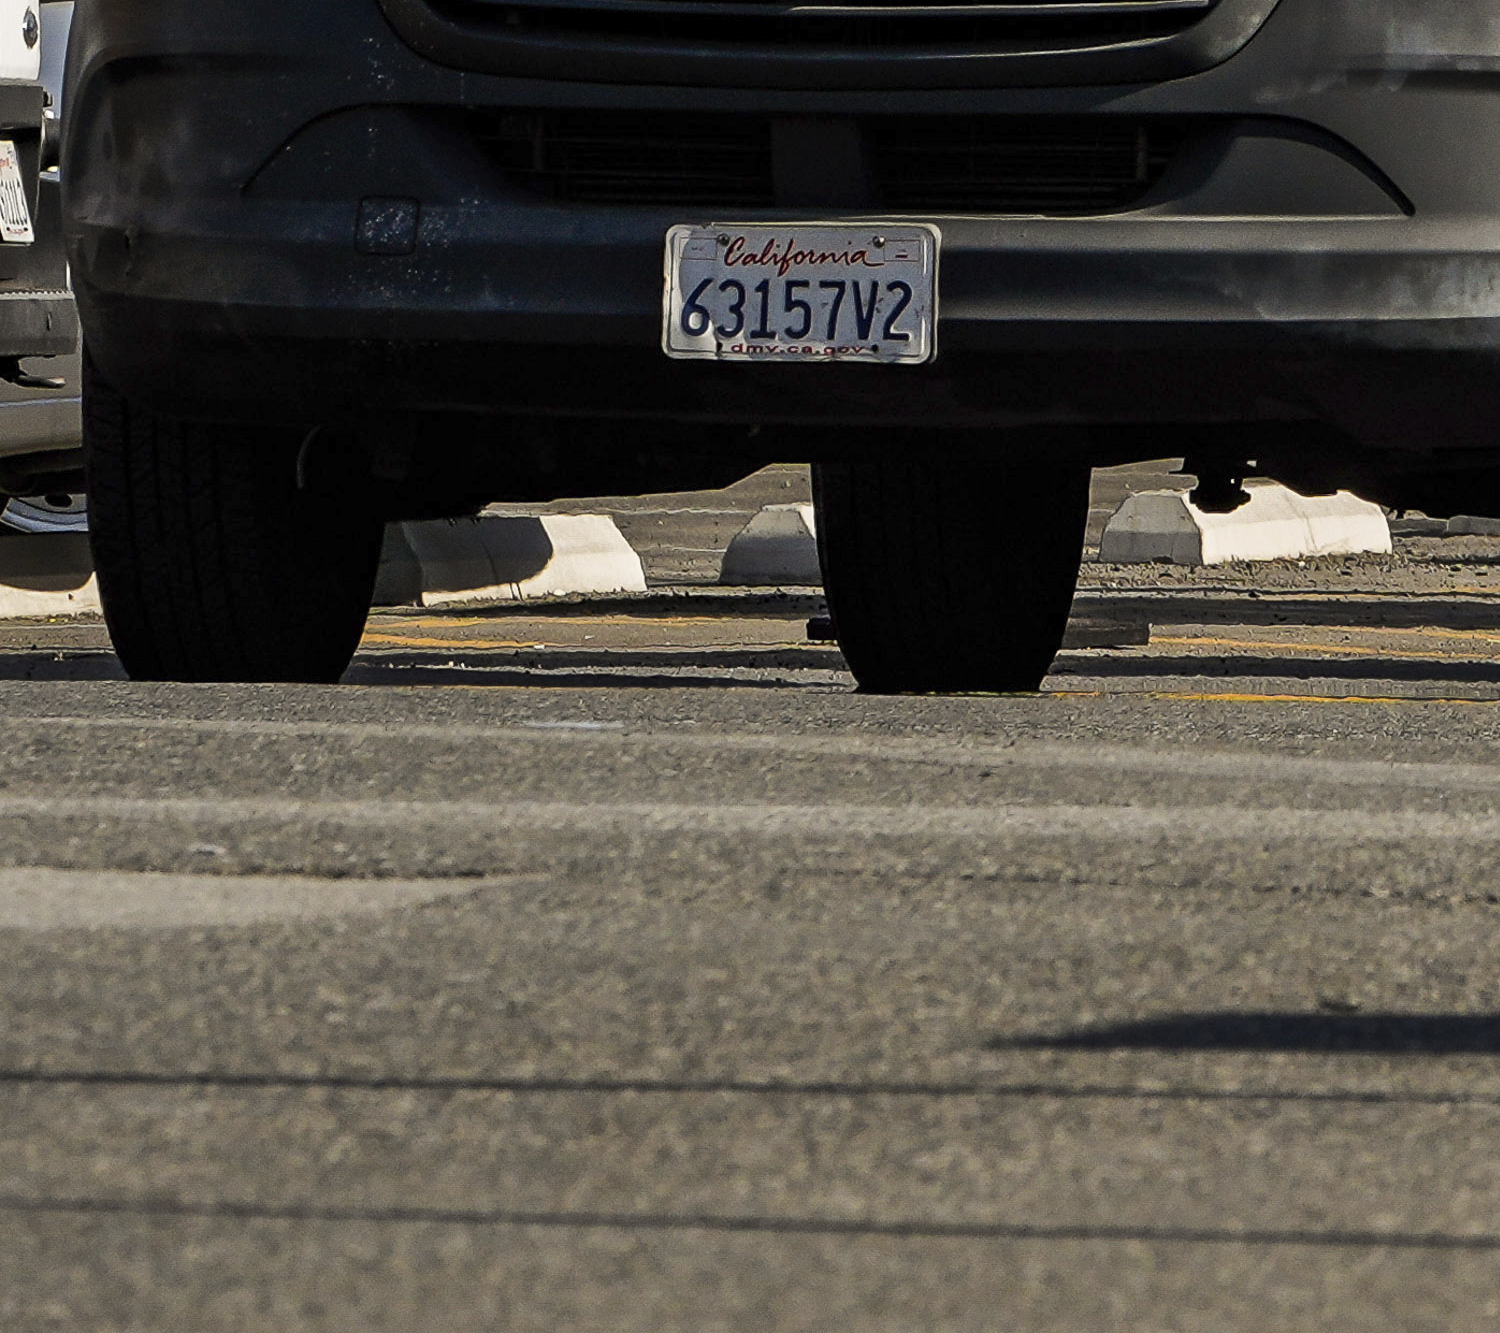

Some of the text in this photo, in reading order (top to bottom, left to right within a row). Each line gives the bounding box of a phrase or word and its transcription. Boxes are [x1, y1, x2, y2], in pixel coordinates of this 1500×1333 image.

[723, 235, 885, 278] California
[680, 278, 913, 341] 63157V2
[729, 342, 867, 355] dmv.ca.gov
